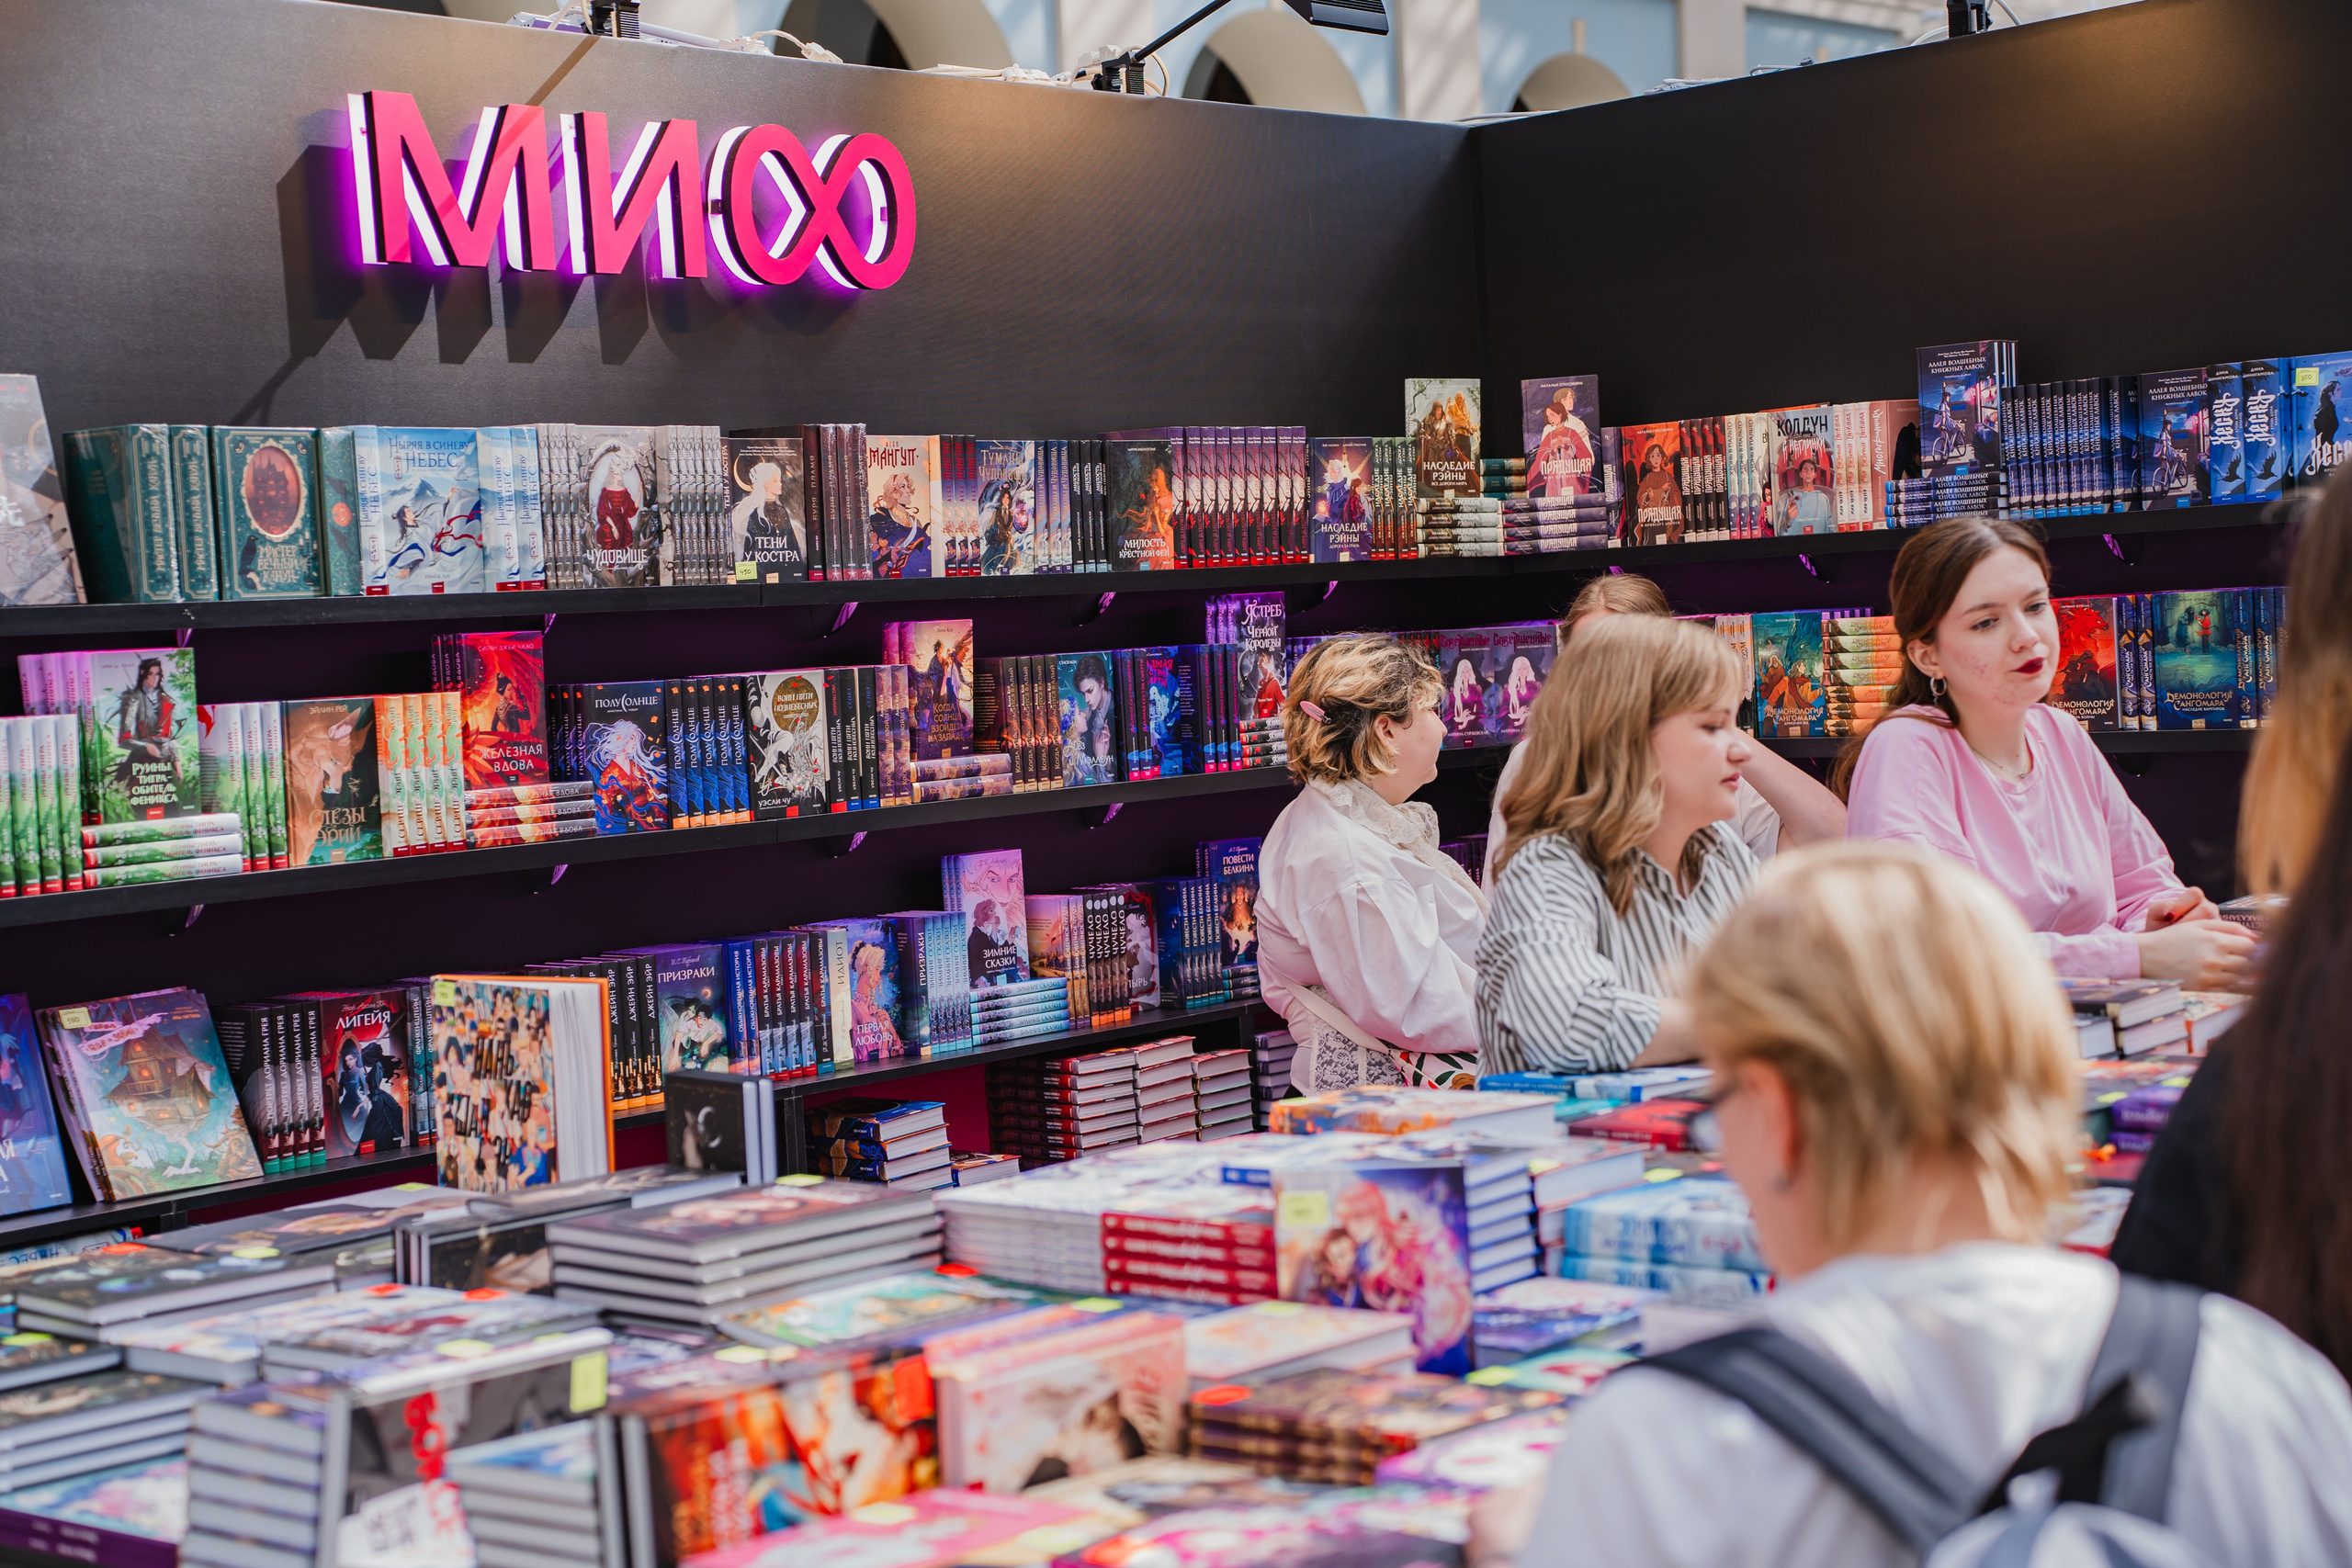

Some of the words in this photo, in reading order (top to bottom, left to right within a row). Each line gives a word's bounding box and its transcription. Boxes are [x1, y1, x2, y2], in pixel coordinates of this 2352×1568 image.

[1949, 356, 1986, 367] ВОЛШЕБНЫХ
[1931, 366, 1963, 374] КНИЖНЫХ
[2151, 392, 2185, 401] КНИЖНЫХ
[2186, 389, 2207, 398] ЛАВОК
[1777, 415, 1828, 437] КОЛДУН
[433, 439, 469, 450] СИНЕВУ
[405, 453, 459, 473] НЕБЕС
[1423, 461, 1476, 470] НАСЛЕДИЕ
[1541, 457, 1592, 475] ПРЯДУЩАЯ
[1432, 470, 1466, 480] РЭЙНЫ
[1637, 505, 1682, 524] ПРЯДУЩАЯ
[1321, 523, 1368, 533] НАСЛЕДИЕ
[755, 536, 788, 549] ТЕНИ
[1125, 537, 1166, 550] МИЛОСТЬ
[1329, 533, 1360, 543] РЭЙНЫ
[257, 546, 297, 560] МИСТЕР
[586, 548, 648, 571] ЧУДОВИЩЕ
[744, 551, 752, 562] У
[755, 550, 800, 562] КОСТРА
[257, 558, 299, 571] ВЕЧНЫЙ
[262, 570, 300, 583] КАНУН
[1241, 600, 1283, 625] ЯСТРЕБ
[595, 694, 658, 713] ПОЛУСОЛНЦЕ
[2165, 690, 2233, 703] ДЕМОНОЛОГИЯ
[2173, 700, 2224, 711] САНГОМАРА
[480, 744, 543, 759] ЖЕЛЕЗНАЯ
[131, 762, 172, 777] РУИНЫ
[493, 761, 534, 773] ВДОВА
[131, 784, 177, 796] ОБИТЕЛЬ
[130, 794, 178, 806] ФЕНИКСА
[758, 799, 781, 807] УЭСЛИ
[1223, 853, 1254, 865] ПОВЕСТИ
[1223, 863, 1254, 875] БЕЛКИНА
[1087, 914, 1095, 960] ЧУЧЕЛО
[1094, 914, 1102, 959] ЧУЧЕЛО
[918, 932, 927, 986] ПРИЗРАКИ
[983, 945, 1016, 959] ЗИМНИЕ
[985, 956, 1016, 969] СКАЗКИ
[658, 965, 716, 984] ПРИЗРАКИ
[628, 988, 638, 1021] ДЖЕЙН
[647, 986, 656, 1019] ДЖЕЙН
[335, 1010, 391, 1030] ЛИГЕЙЯ
[261, 1017, 269, 1038] ГРЕЯ
[857, 1021, 889, 1034] ПЕРВАЯ
[855, 1032, 893, 1046] ЛЮБОВЬ
[263, 1040, 273, 1079] ДОРИАНА
[310, 1033, 320, 1073] ДОРИАНА
[311, 1073, 321, 1111] ПОРТРЕТ
[265, 1080, 274, 1120] ПОРТРЕТ
